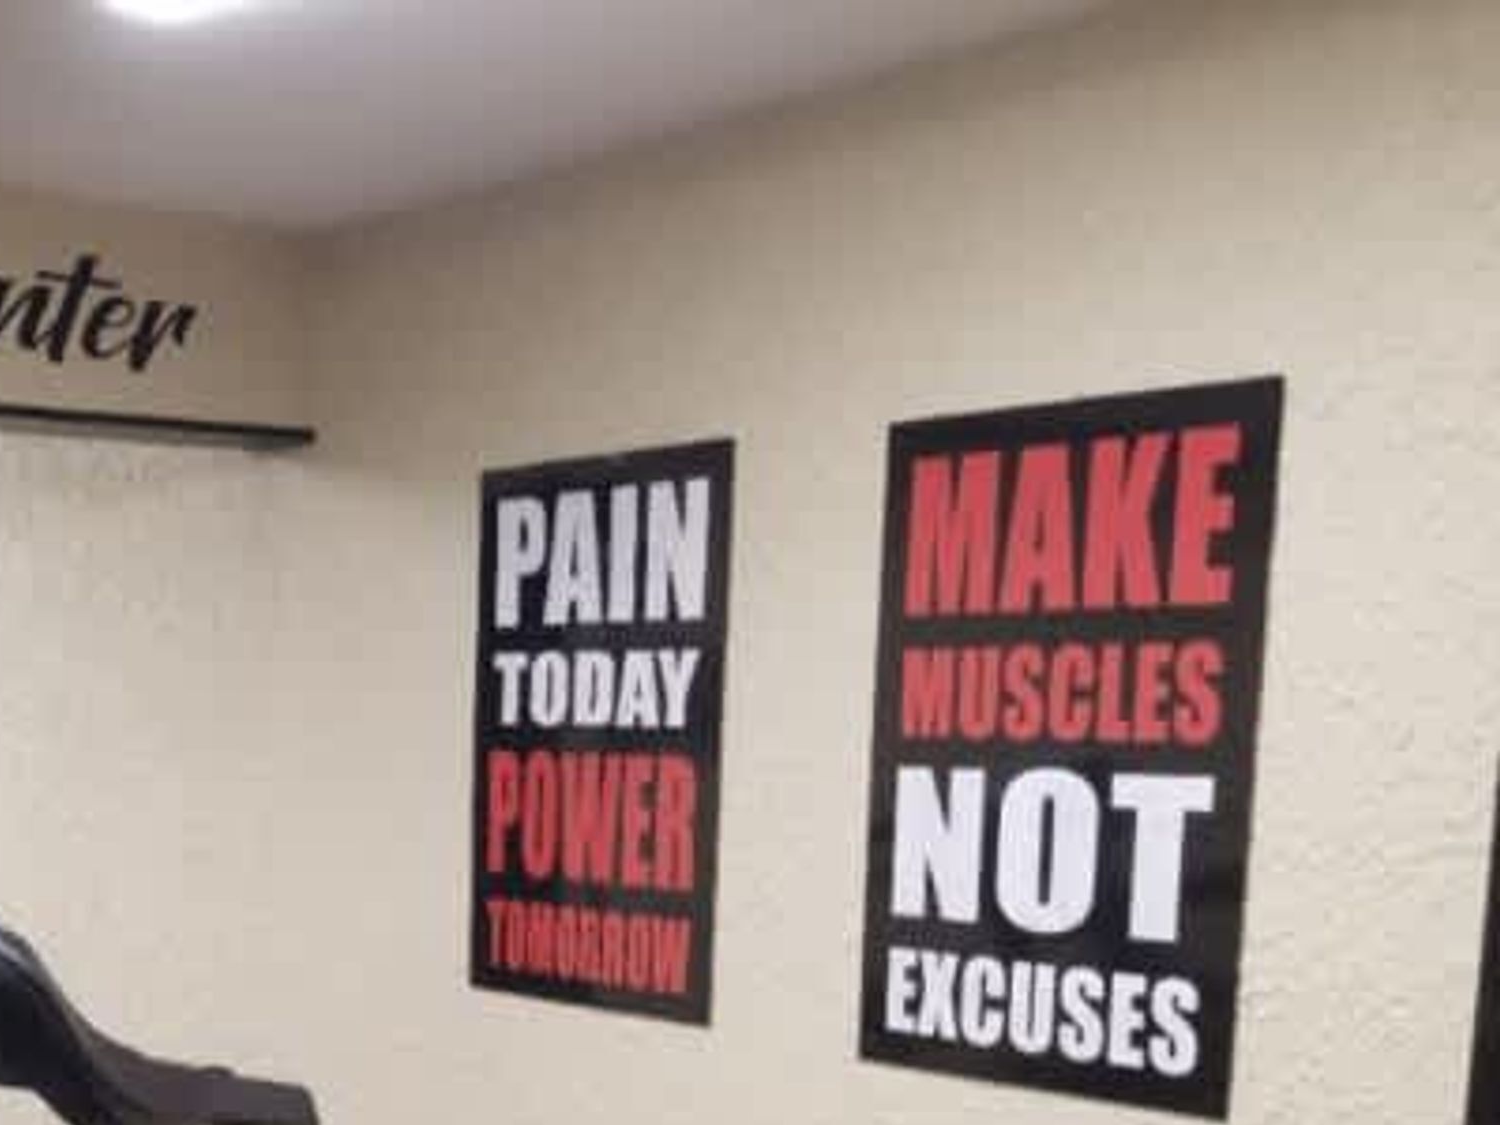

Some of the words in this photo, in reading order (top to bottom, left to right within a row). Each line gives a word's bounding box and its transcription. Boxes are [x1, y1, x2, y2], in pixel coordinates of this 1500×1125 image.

[494, 477, 710, 628] PAIN
[904, 422, 1243, 617] MAKE
[494, 648, 700, 729] TODAY
[902, 640, 1224, 746] MUSCLES
[486, 750, 696, 891] POWER
[890, 766, 1216, 943] NOT
[487, 900, 690, 993] TOMORROW
[885, 947, 1200, 1079] EXCUSES
